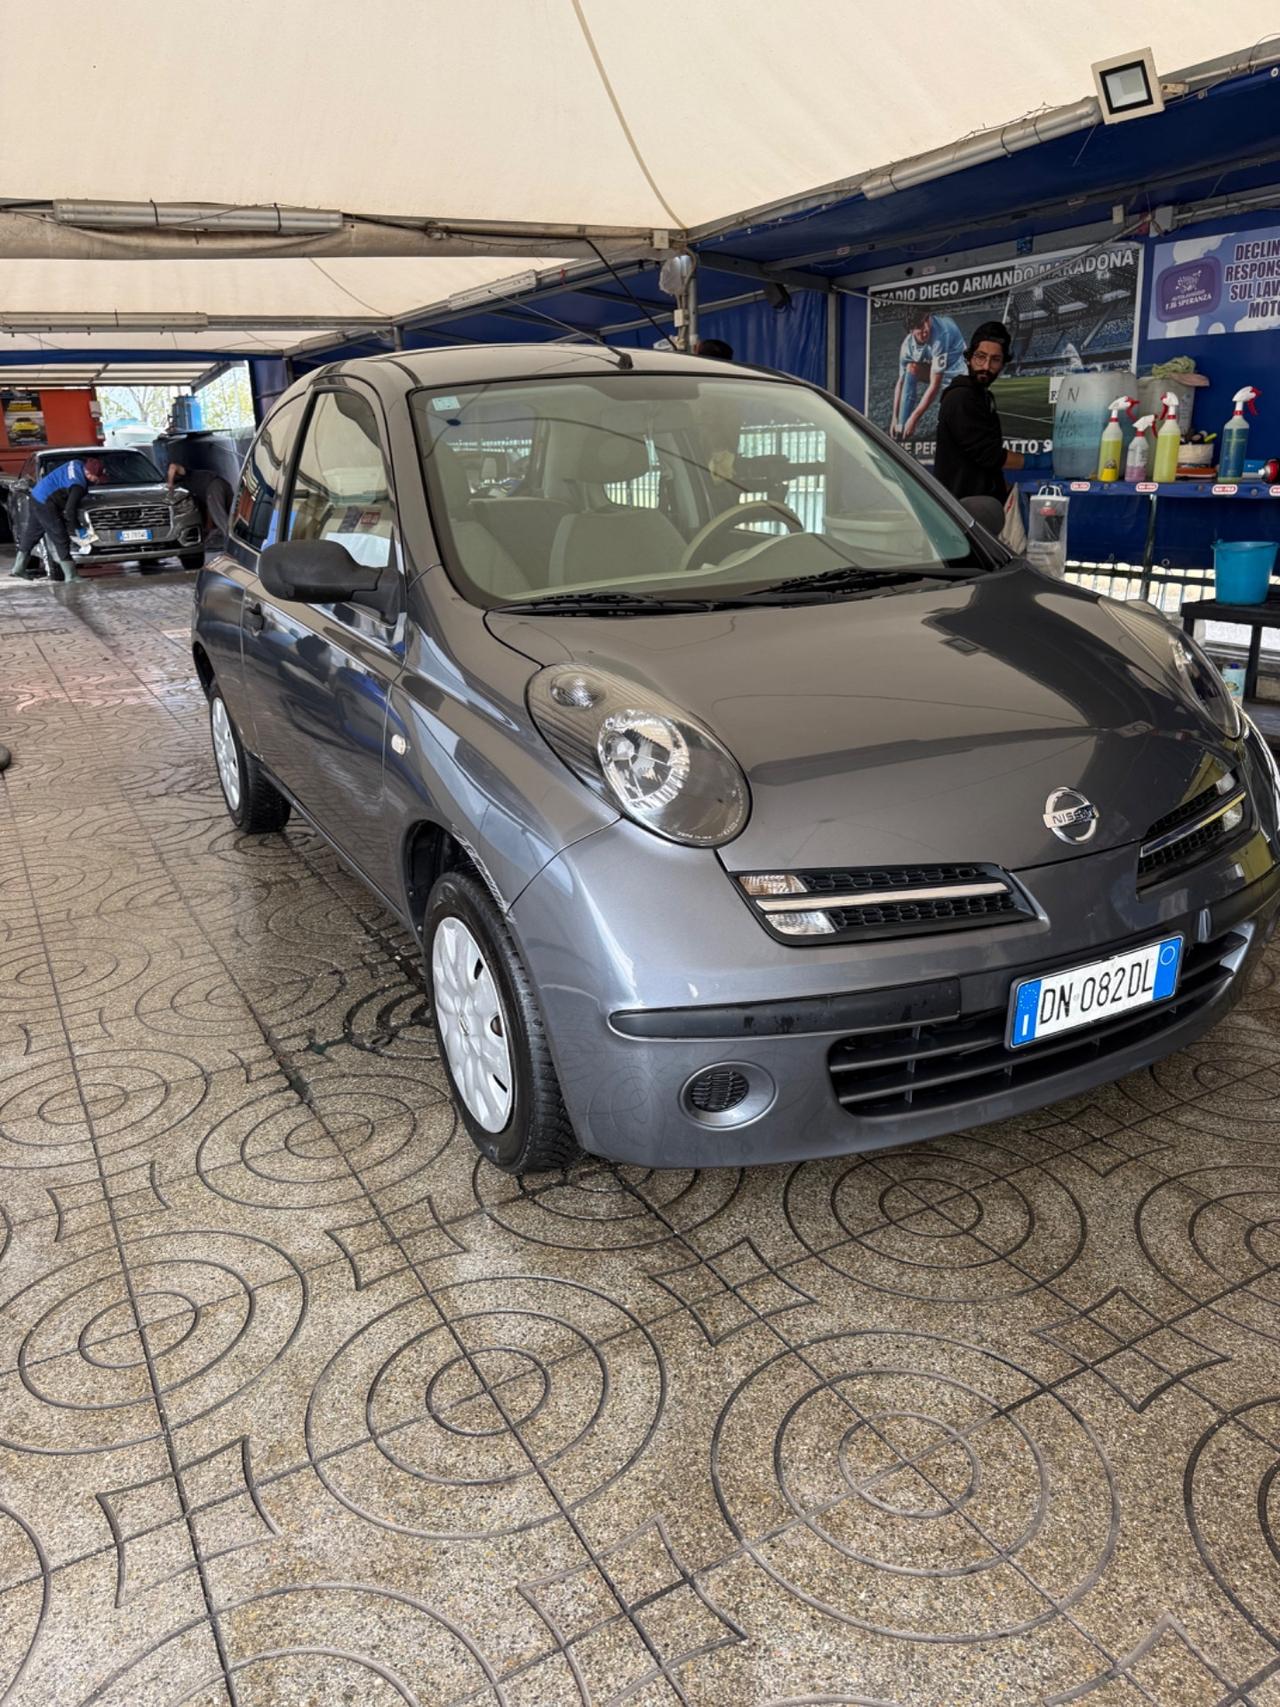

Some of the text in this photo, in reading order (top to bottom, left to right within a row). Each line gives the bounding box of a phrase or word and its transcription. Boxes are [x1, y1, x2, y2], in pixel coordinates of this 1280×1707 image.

[874, 249, 1134, 308] STADIO DIEGO ARMANDO MARADONA
[1230, 280, 1280, 301] SUL LAV
[1039, 958, 1153, 1025] DN 082DL
